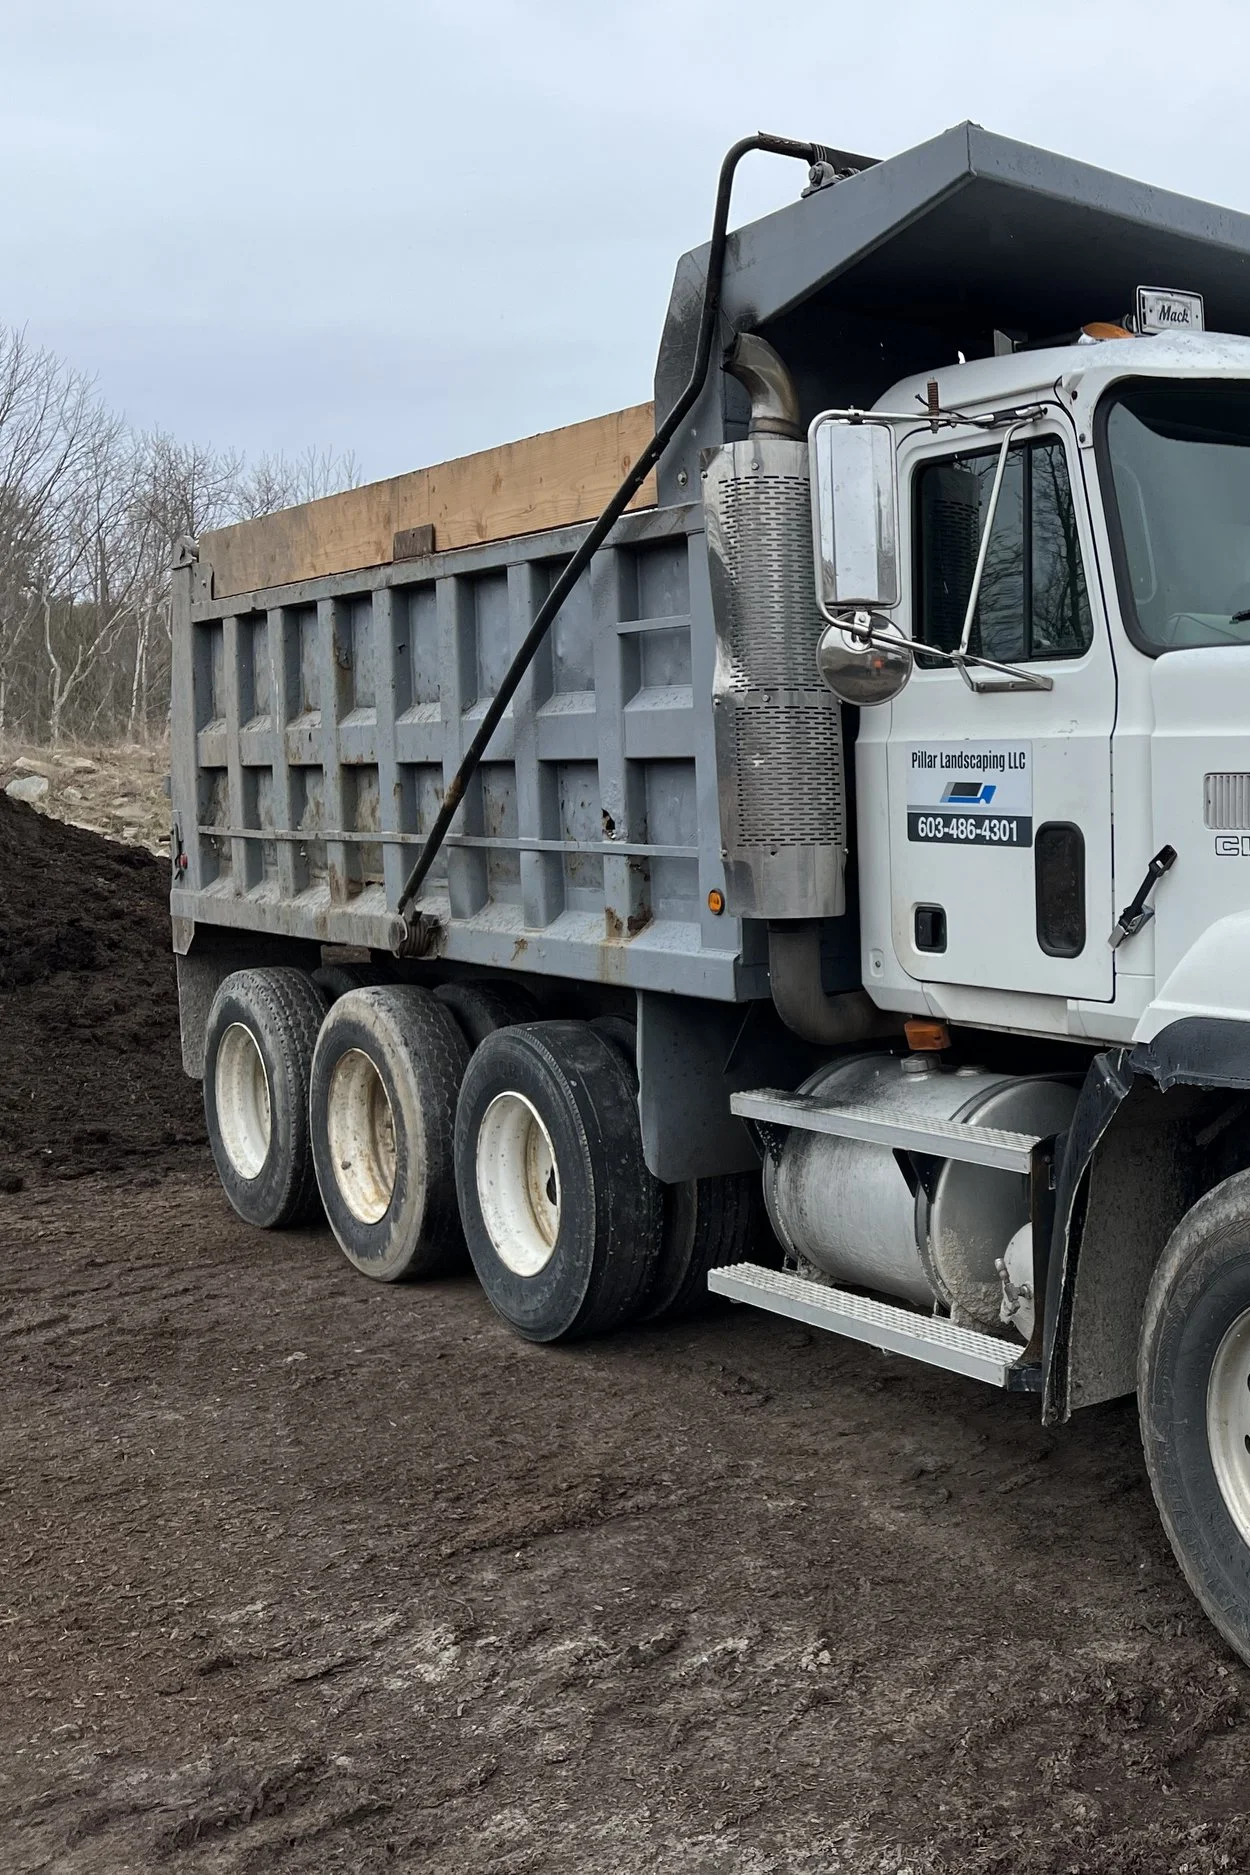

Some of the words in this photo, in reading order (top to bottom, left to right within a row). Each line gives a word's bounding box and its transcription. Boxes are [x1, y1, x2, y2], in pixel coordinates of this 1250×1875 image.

[1159, 304, 1189, 323] Mack
[911, 750, 938, 769] Pillar
[940, 750, 1005, 772] Landscaping
[1008, 751, 1026, 770] LLC
[918, 816, 1017, 842] 603-486-4301
